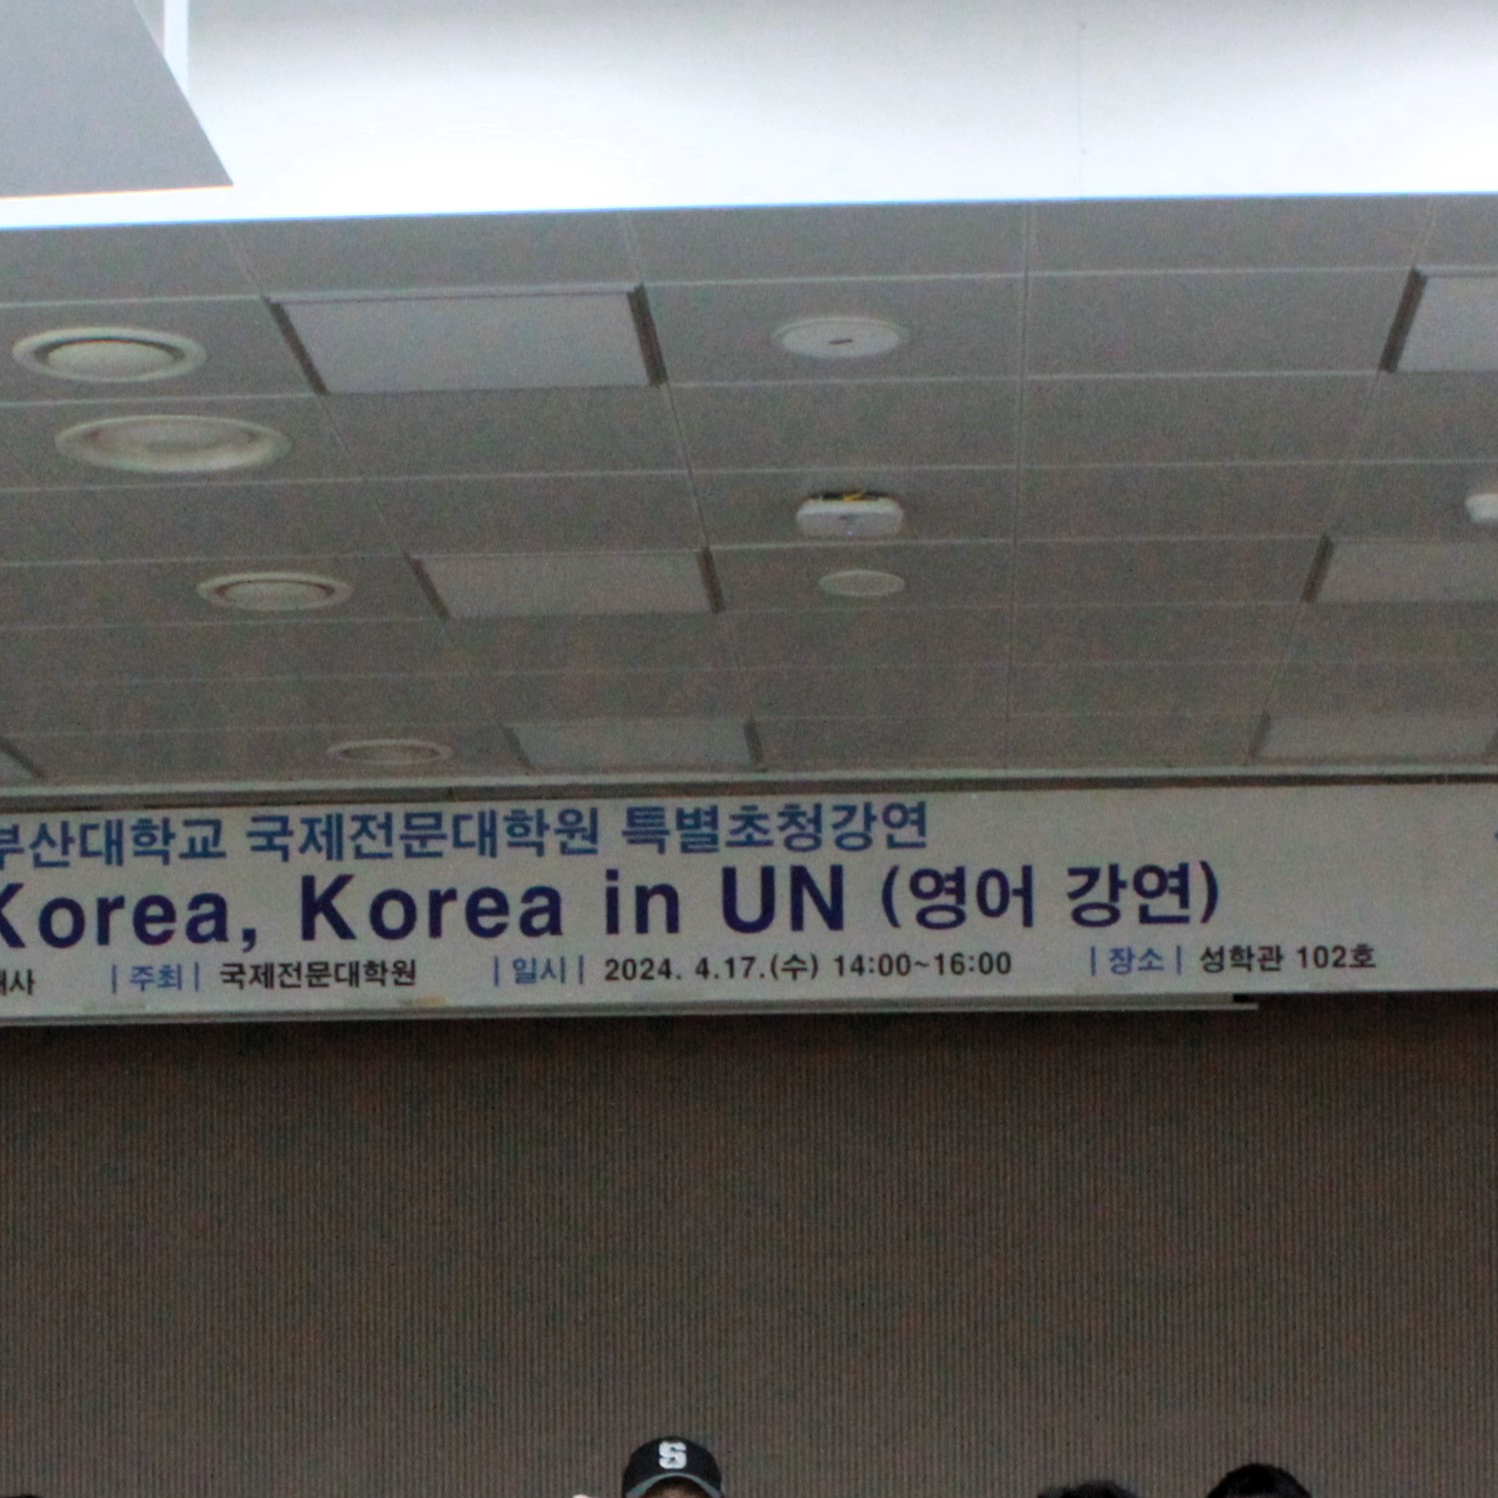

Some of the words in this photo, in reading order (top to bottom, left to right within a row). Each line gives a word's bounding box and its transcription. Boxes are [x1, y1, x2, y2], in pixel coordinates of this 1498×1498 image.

[245, 807, 600, 863] 국제전문대학원
[622, 800, 927, 854] 특별초청강연
[301, 874, 562, 941] Korea
[605, 868, 680, 935] in
[721, 863, 844, 934] UN
[881, 864, 1034, 930] (영어
[1067, 860, 1219, 928] 강연)
[130, 965, 182, 992] 주최
[220, 959, 416, 990] 국제전문대학원
[512, 956, 567, 985] 일시
[605, 957, 681, 981] 2024.
[834, 951, 1012, 977] 14:00~16:00
[1109, 947, 1164, 975] 장소
[1200, 944, 1284, 974] 성학관
[1297, 943, 1377, 969] 102호
[659, 1441, 687, 1469] S
